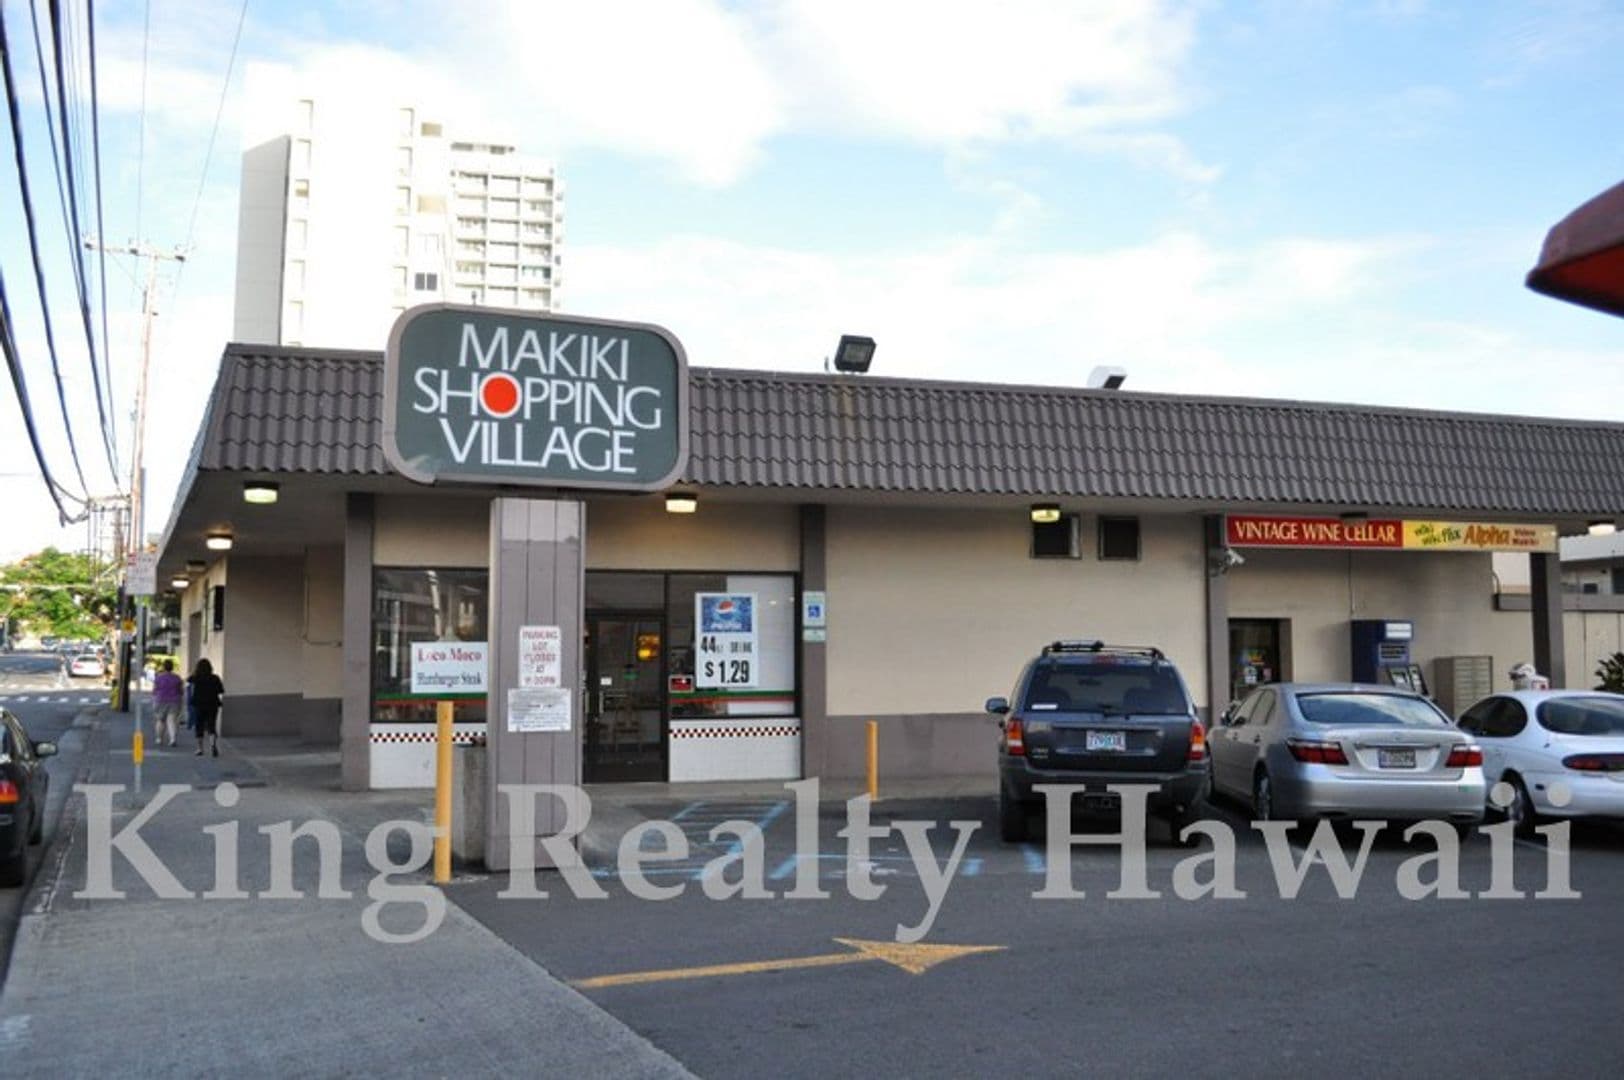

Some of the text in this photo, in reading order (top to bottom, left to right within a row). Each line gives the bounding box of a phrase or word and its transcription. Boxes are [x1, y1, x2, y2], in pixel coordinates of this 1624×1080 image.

[458, 323, 629, 381] MAKIKI
[413, 367, 661, 429] SHOPPING
[439, 418, 637, 473] VILLAGE
[1235, 521, 1298, 540] VINTAGE
[1303, 523, 1341, 541] WINE
[1344, 523, 1395, 542] CELLAR
